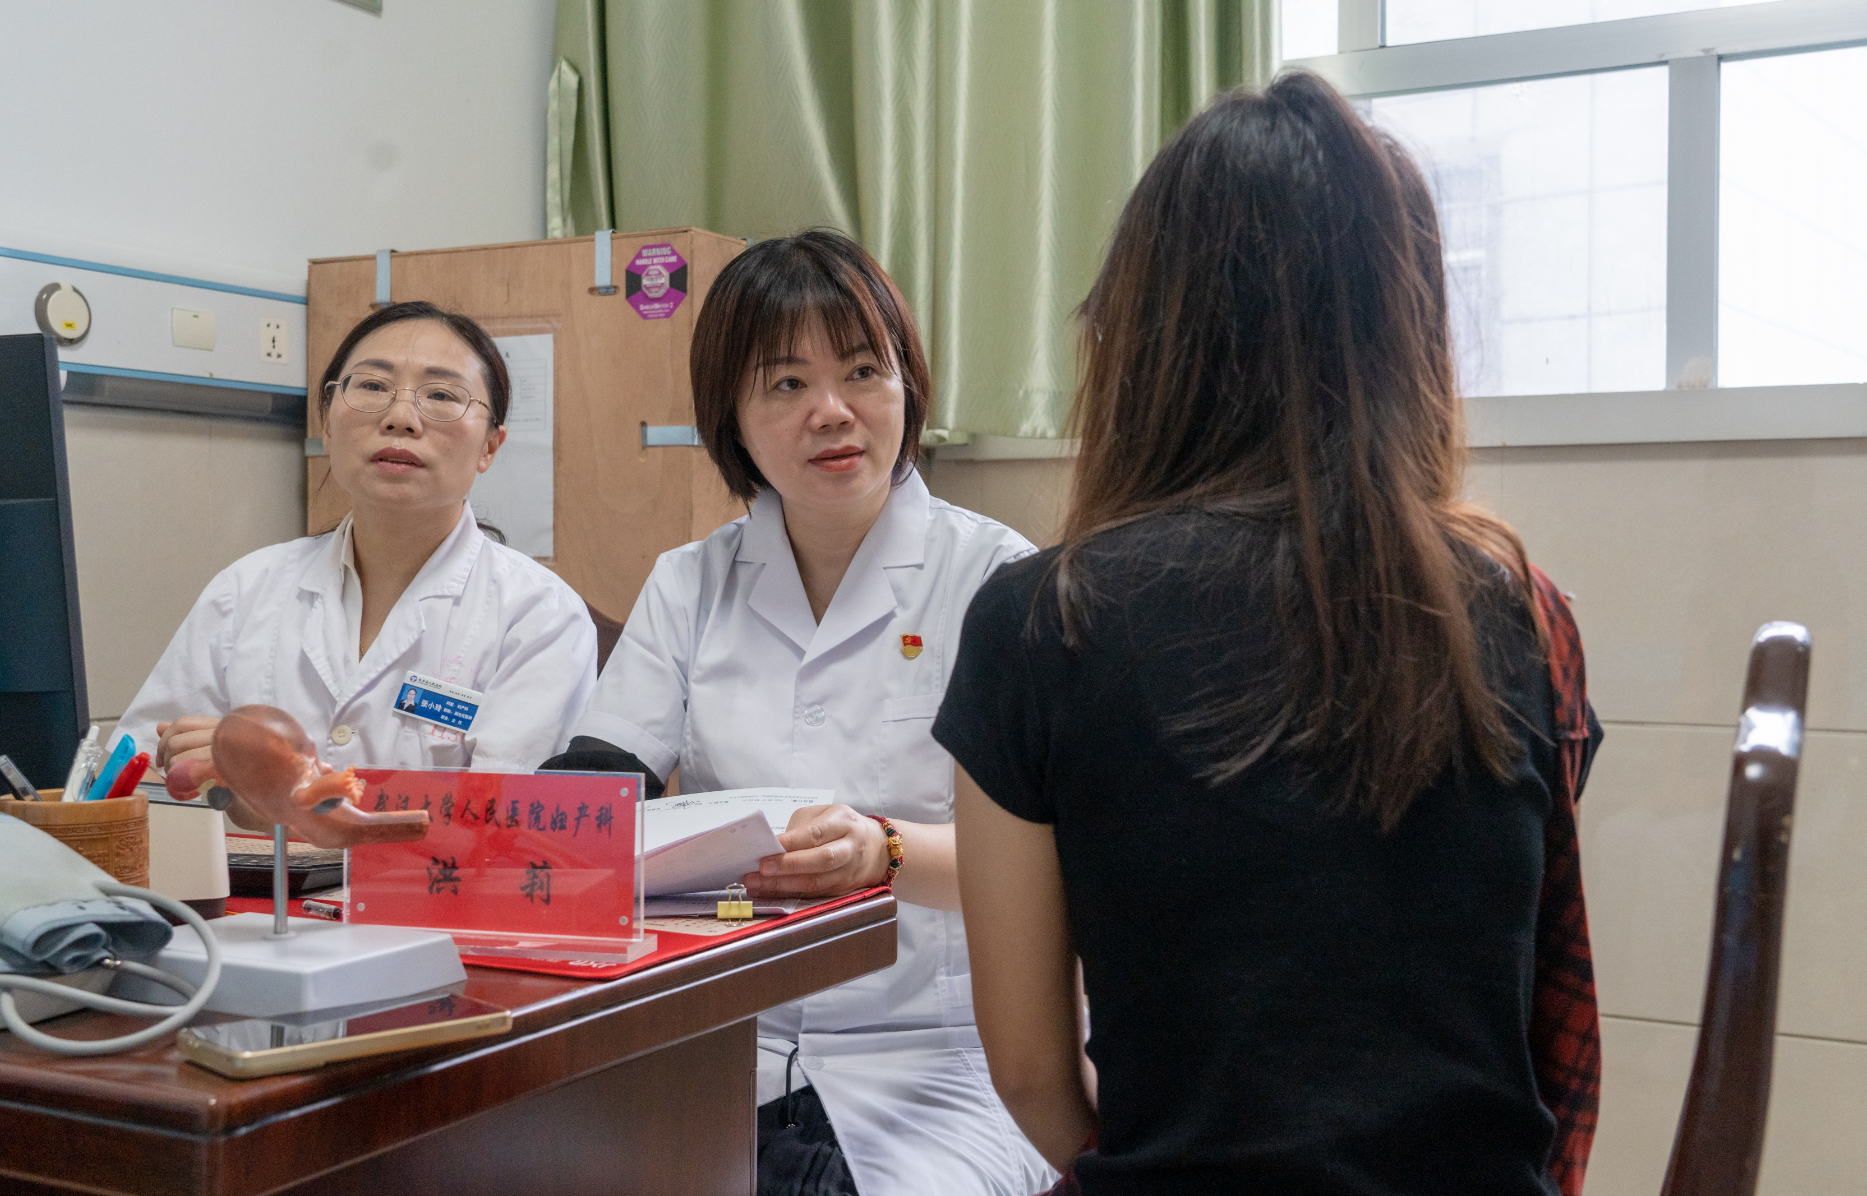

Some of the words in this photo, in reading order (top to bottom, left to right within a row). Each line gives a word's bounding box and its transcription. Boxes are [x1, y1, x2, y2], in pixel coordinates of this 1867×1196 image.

[642, 247, 671, 257] WARNING
[665, 255, 677, 263] CARE
[374, 787, 613, 839] 武汉大学人民医院妇产科
